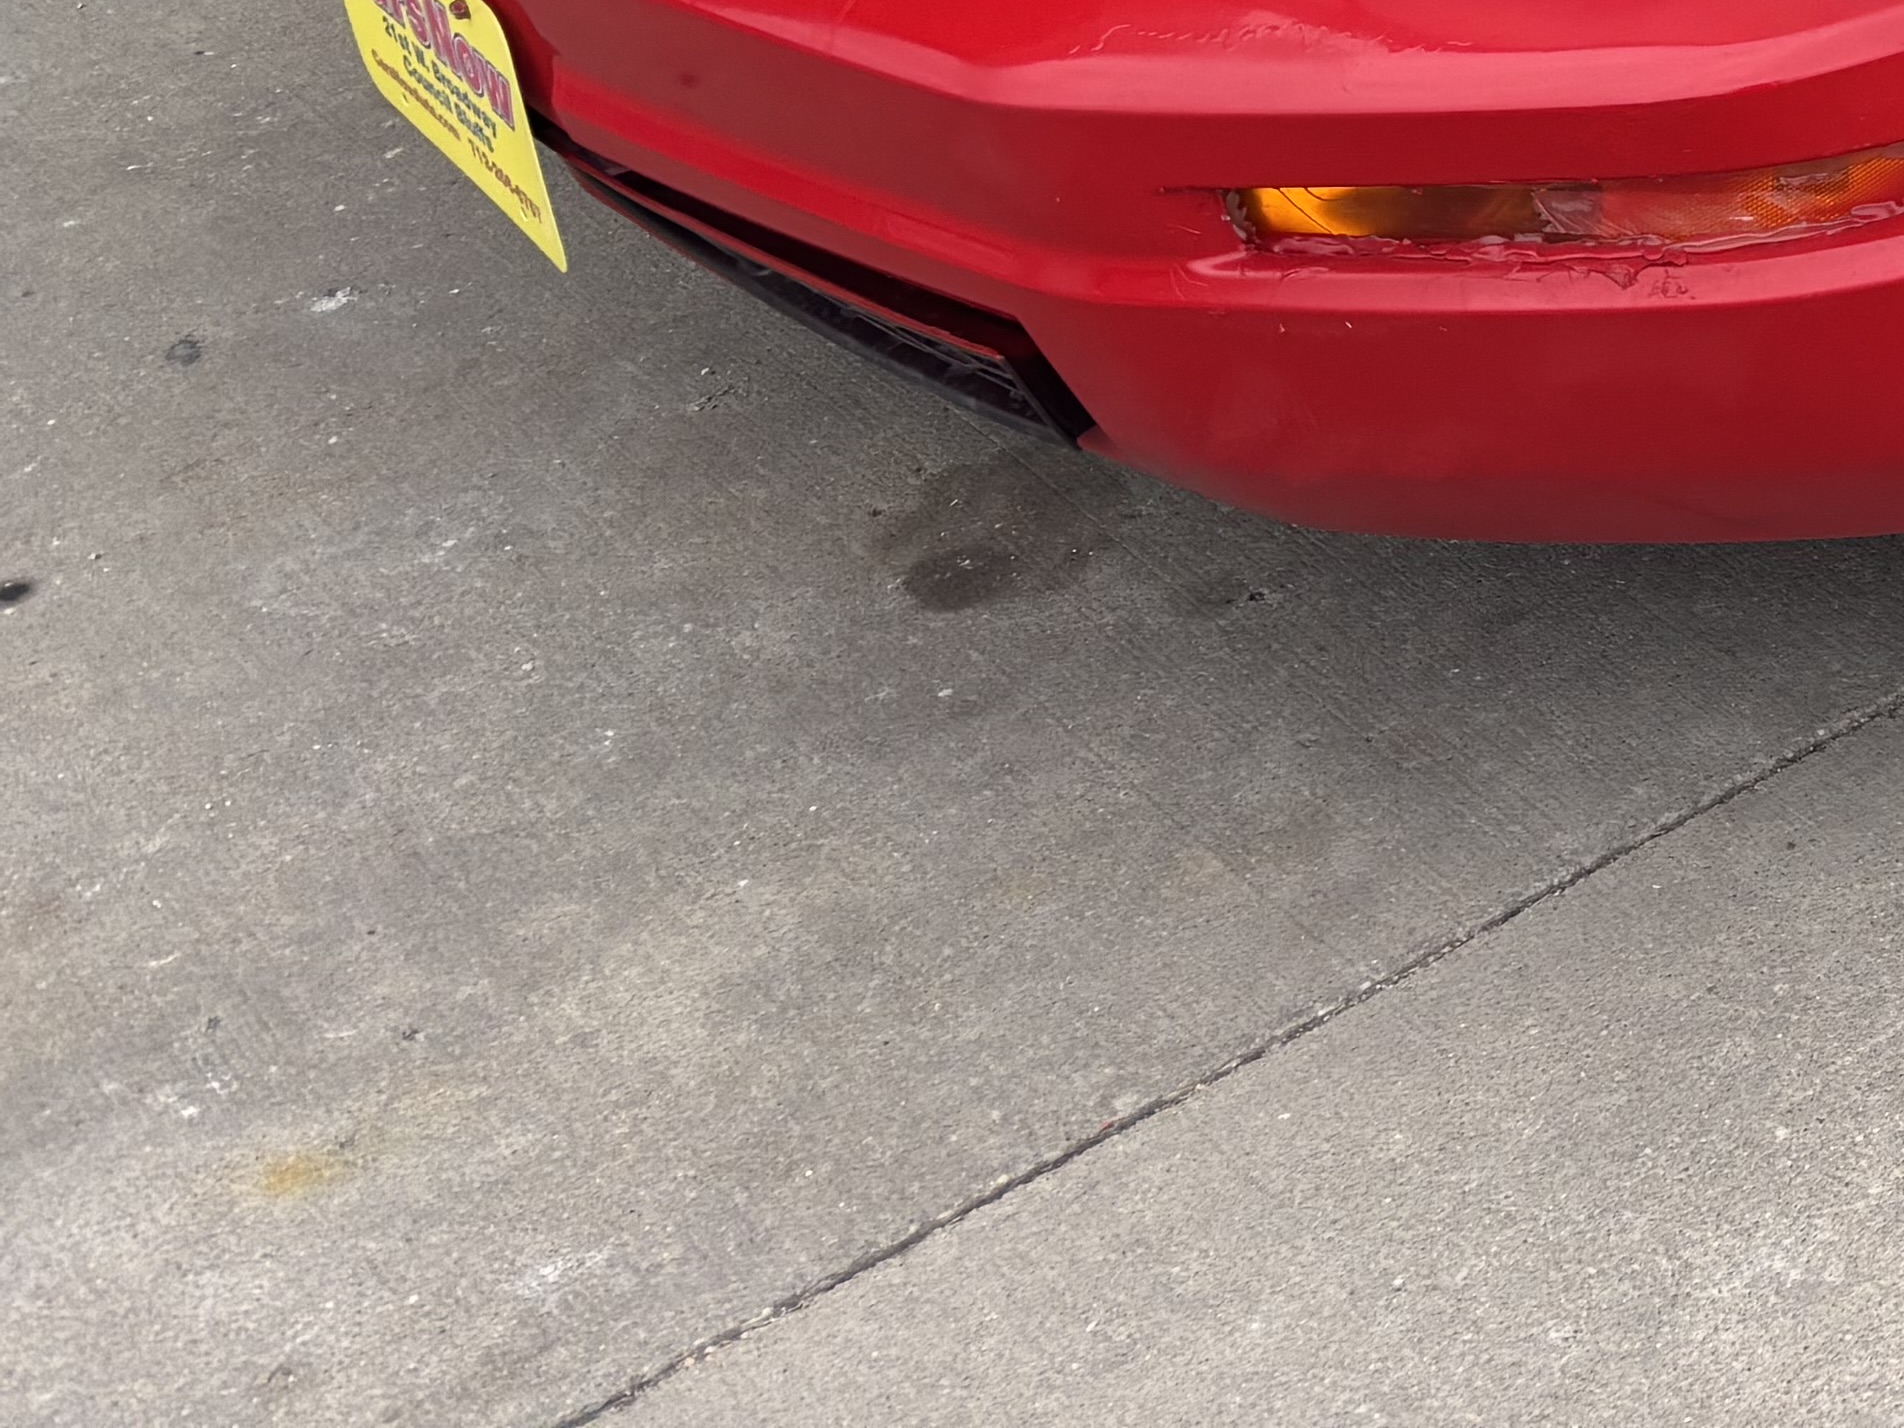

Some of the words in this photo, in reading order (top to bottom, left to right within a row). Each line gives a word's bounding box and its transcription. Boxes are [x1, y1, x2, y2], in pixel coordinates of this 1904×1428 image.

[382, 15, 412, 56] 21st
[412, 41, 430, 72] W.
[432, 60, 497, 139] Broadway
[402, 55, 452, 113] Council
[454, 101, 494, 153] Bluffs
